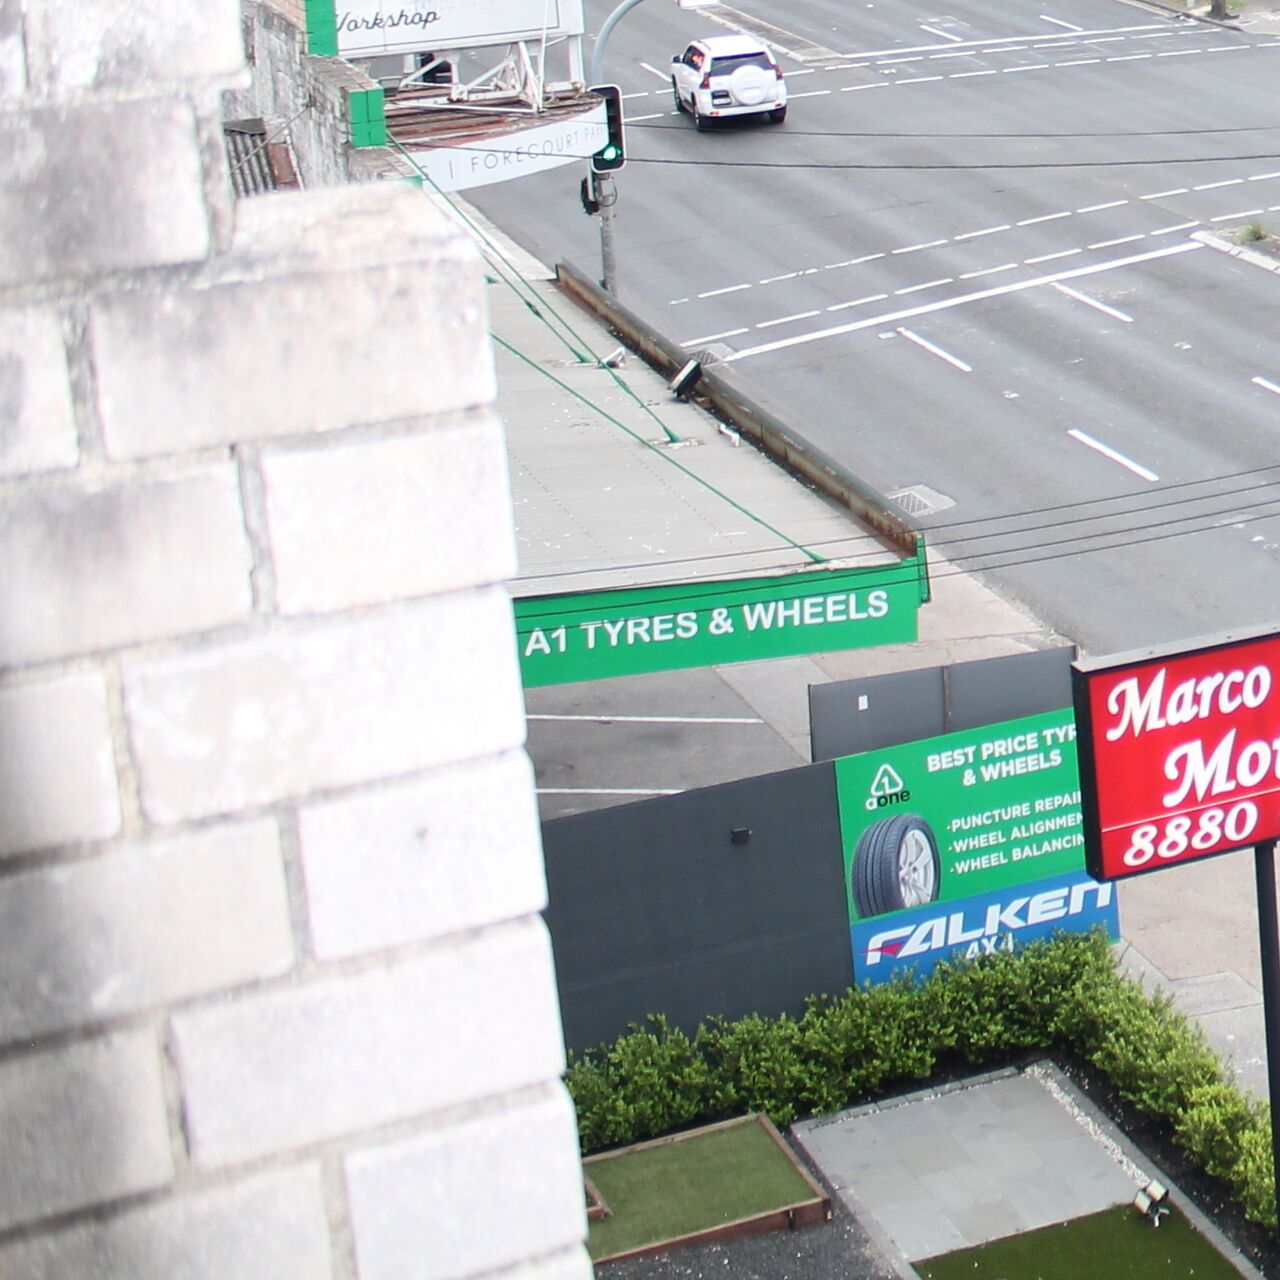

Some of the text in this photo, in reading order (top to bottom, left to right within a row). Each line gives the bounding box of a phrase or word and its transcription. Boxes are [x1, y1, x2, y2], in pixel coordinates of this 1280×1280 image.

[471, 131, 579, 172] FORECOURT
[524, 590, 889, 657] A1 TYRES & WHEELS
[1105, 665, 1271, 742] Marco
[926, 746, 975, 772] BEST
[981, 732, 1039, 761] PRICE
[962, 749, 1062, 787] & WHEELS
[865, 788, 911, 811] aone
[951, 790, 1082, 832] PUNCTURE REPAI
[953, 829, 1007, 853] WHEEL
[1123, 801, 1258, 867] 8880
[955, 852, 1009, 875] WHEEL
[864, 880, 1113, 967] FALKEN
